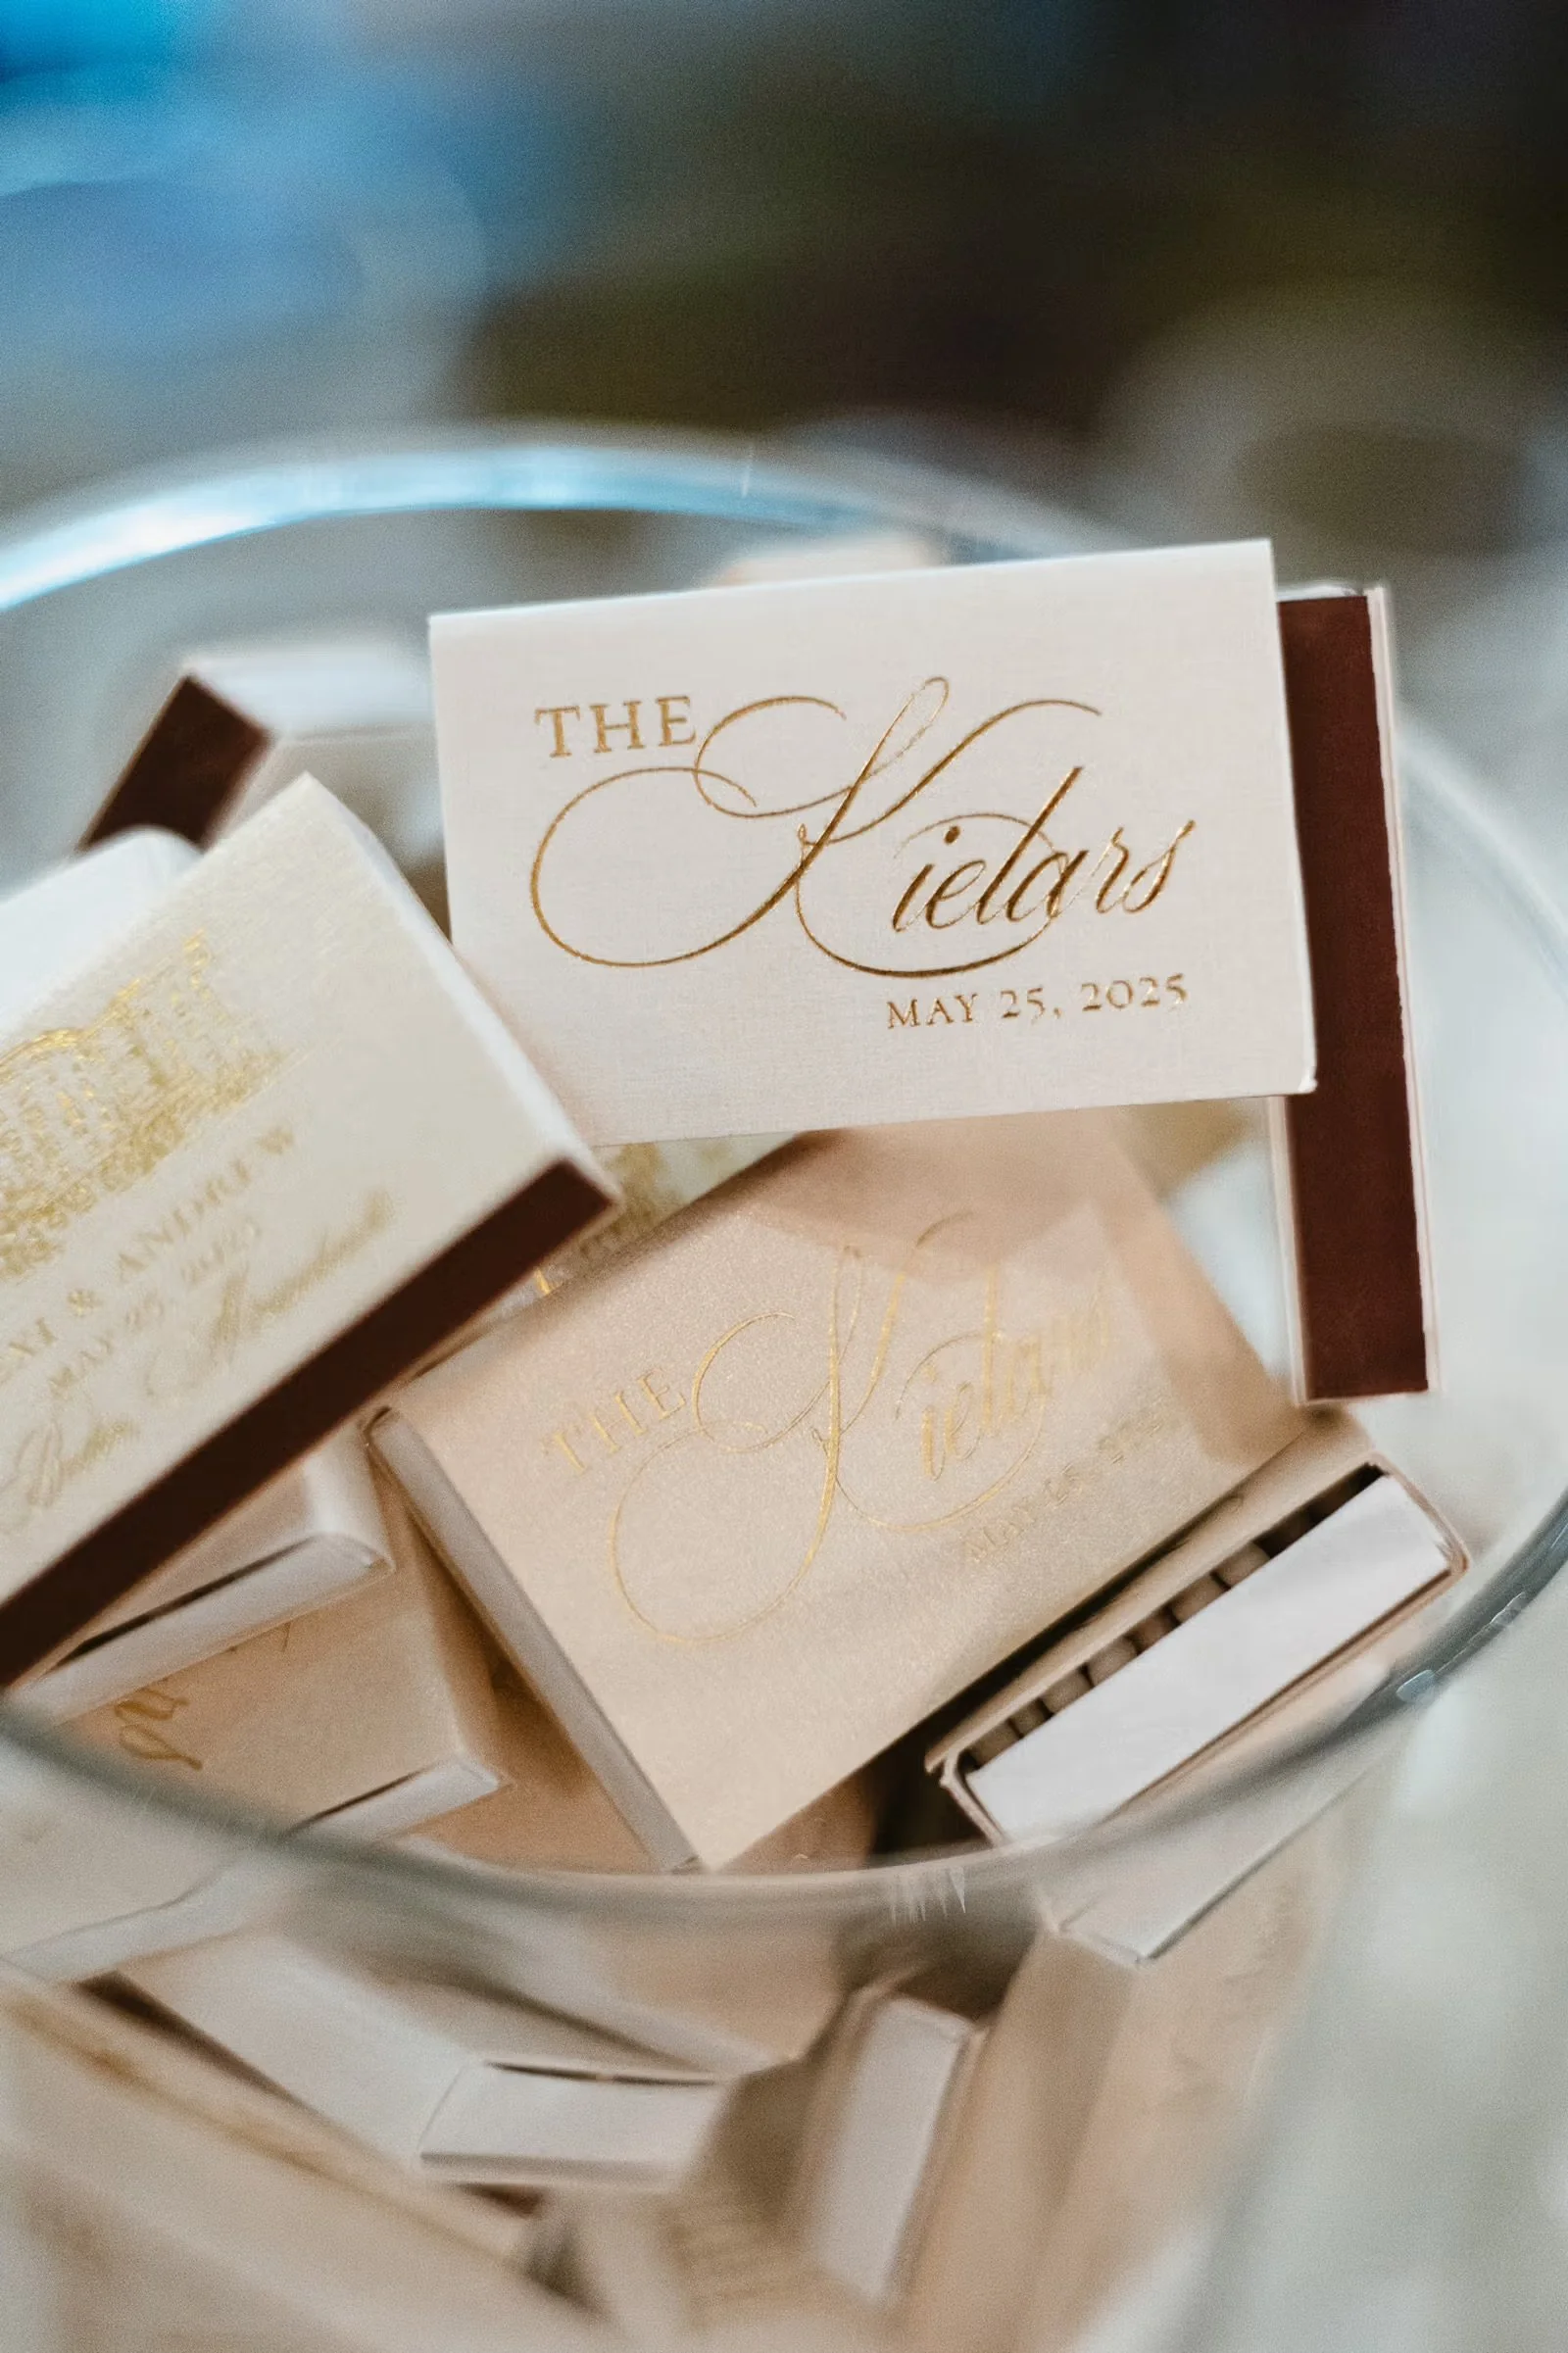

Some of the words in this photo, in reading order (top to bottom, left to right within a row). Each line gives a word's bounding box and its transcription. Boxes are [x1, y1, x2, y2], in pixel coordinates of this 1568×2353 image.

[534, 695, 697, 758] THE
[530, 677, 1195, 977] Kielars
[887, 994, 977, 1029] MAY
[1000, 985, 1062, 1025] 25,
[1081, 973, 1188, 1012] 2025
[542, 1368, 687, 1475] THE
